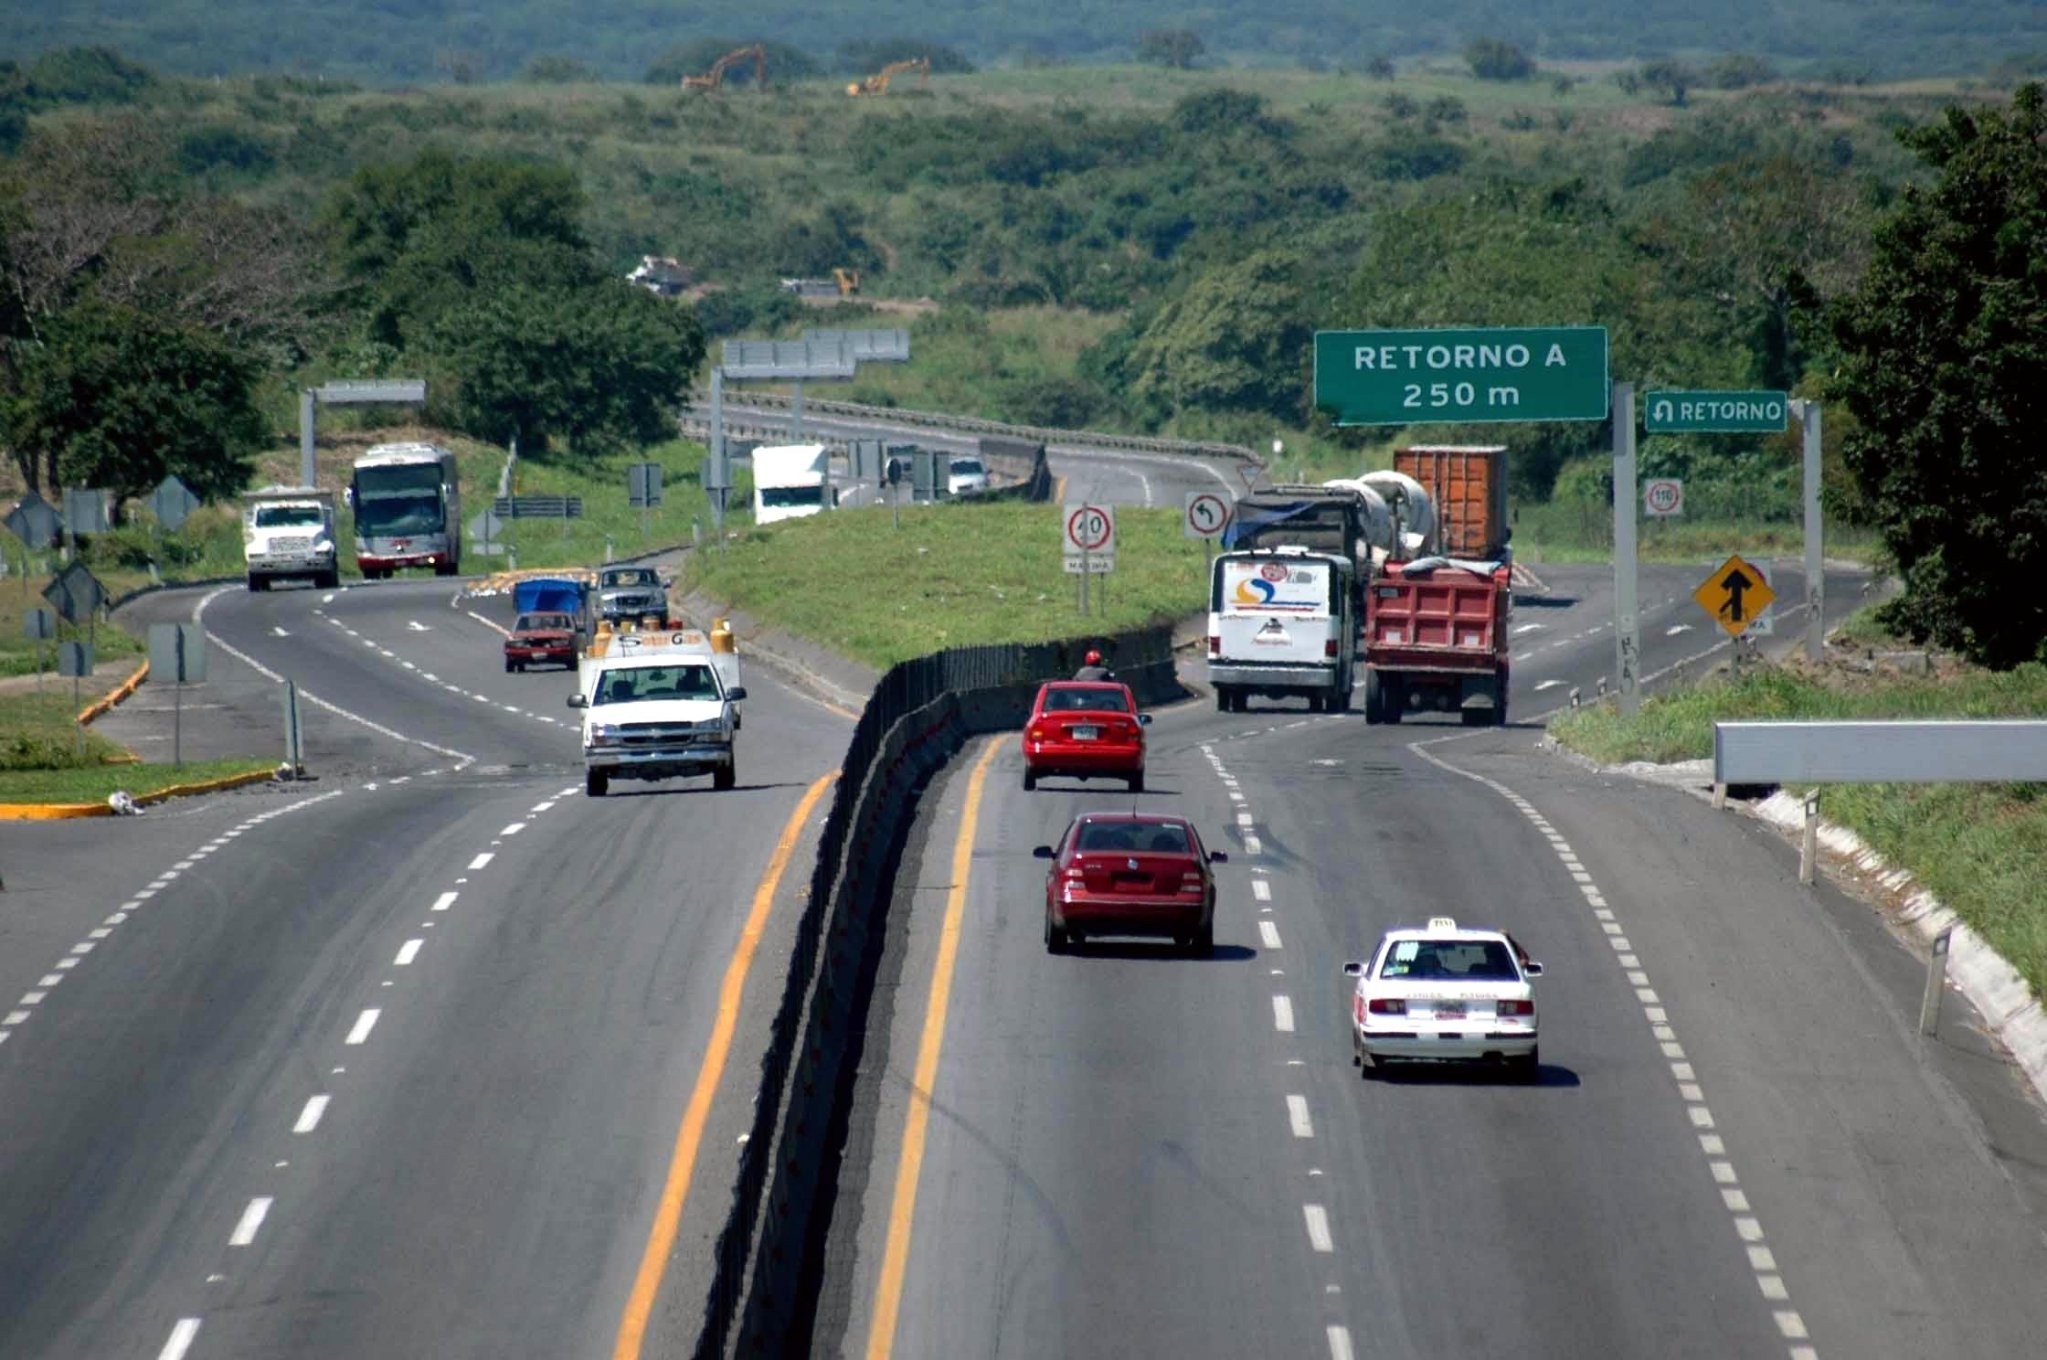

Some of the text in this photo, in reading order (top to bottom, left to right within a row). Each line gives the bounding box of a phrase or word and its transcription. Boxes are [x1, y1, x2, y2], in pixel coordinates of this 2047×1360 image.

[1354, 343, 1567, 370] RETORNO A
[1403, 382, 1520, 408] 250 m
[1680, 401, 1781, 421] RETORNO
